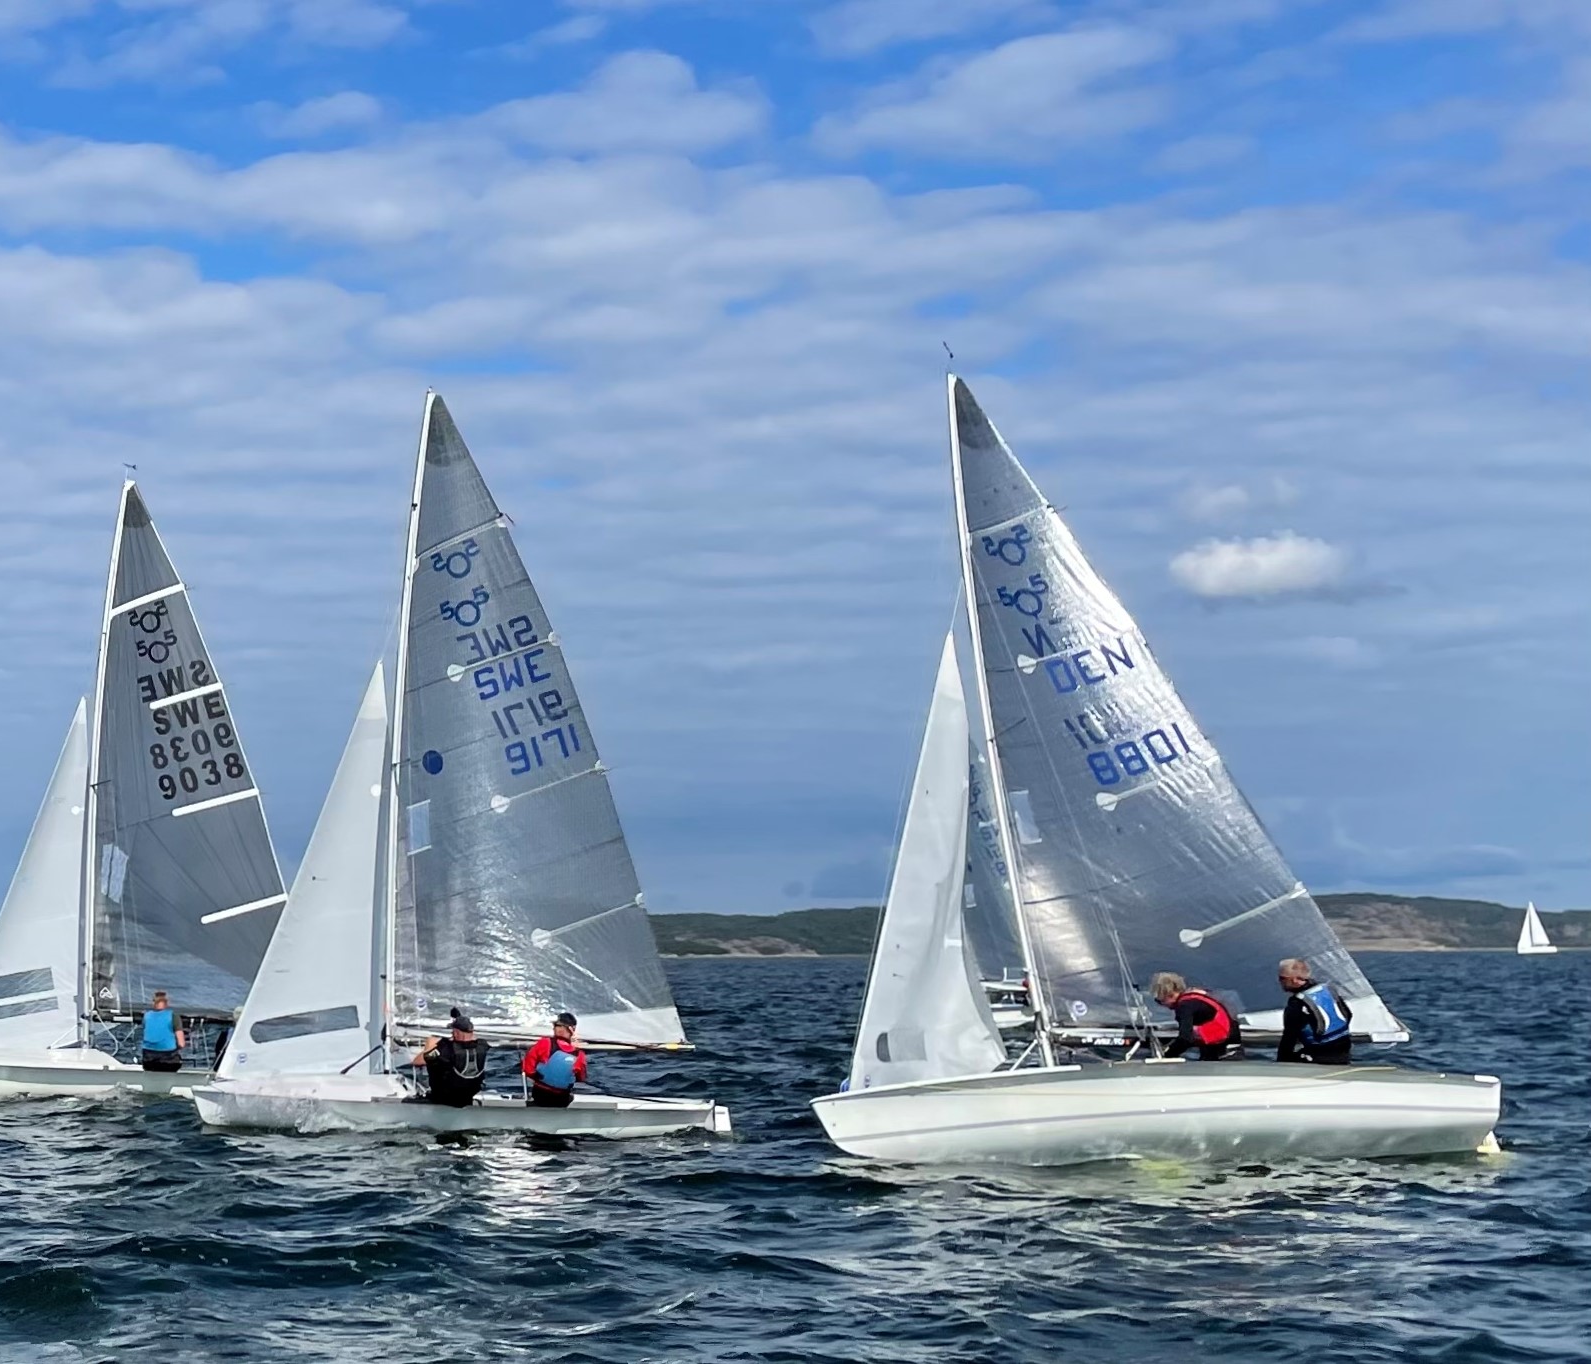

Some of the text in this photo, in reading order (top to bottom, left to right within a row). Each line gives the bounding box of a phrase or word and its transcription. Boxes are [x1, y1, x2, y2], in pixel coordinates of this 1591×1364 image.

[439, 584, 490, 627] 505
[996, 573, 1049, 617] 505
[136, 629, 178, 664] 505
[1044, 637, 1135, 694] DEN
[473, 648, 552, 701] SWE
[153, 692, 226, 735] SWE
[505, 723, 580, 776] 9171
[1086, 722, 1191, 786] 8801
[158, 752, 244, 800] 9038
